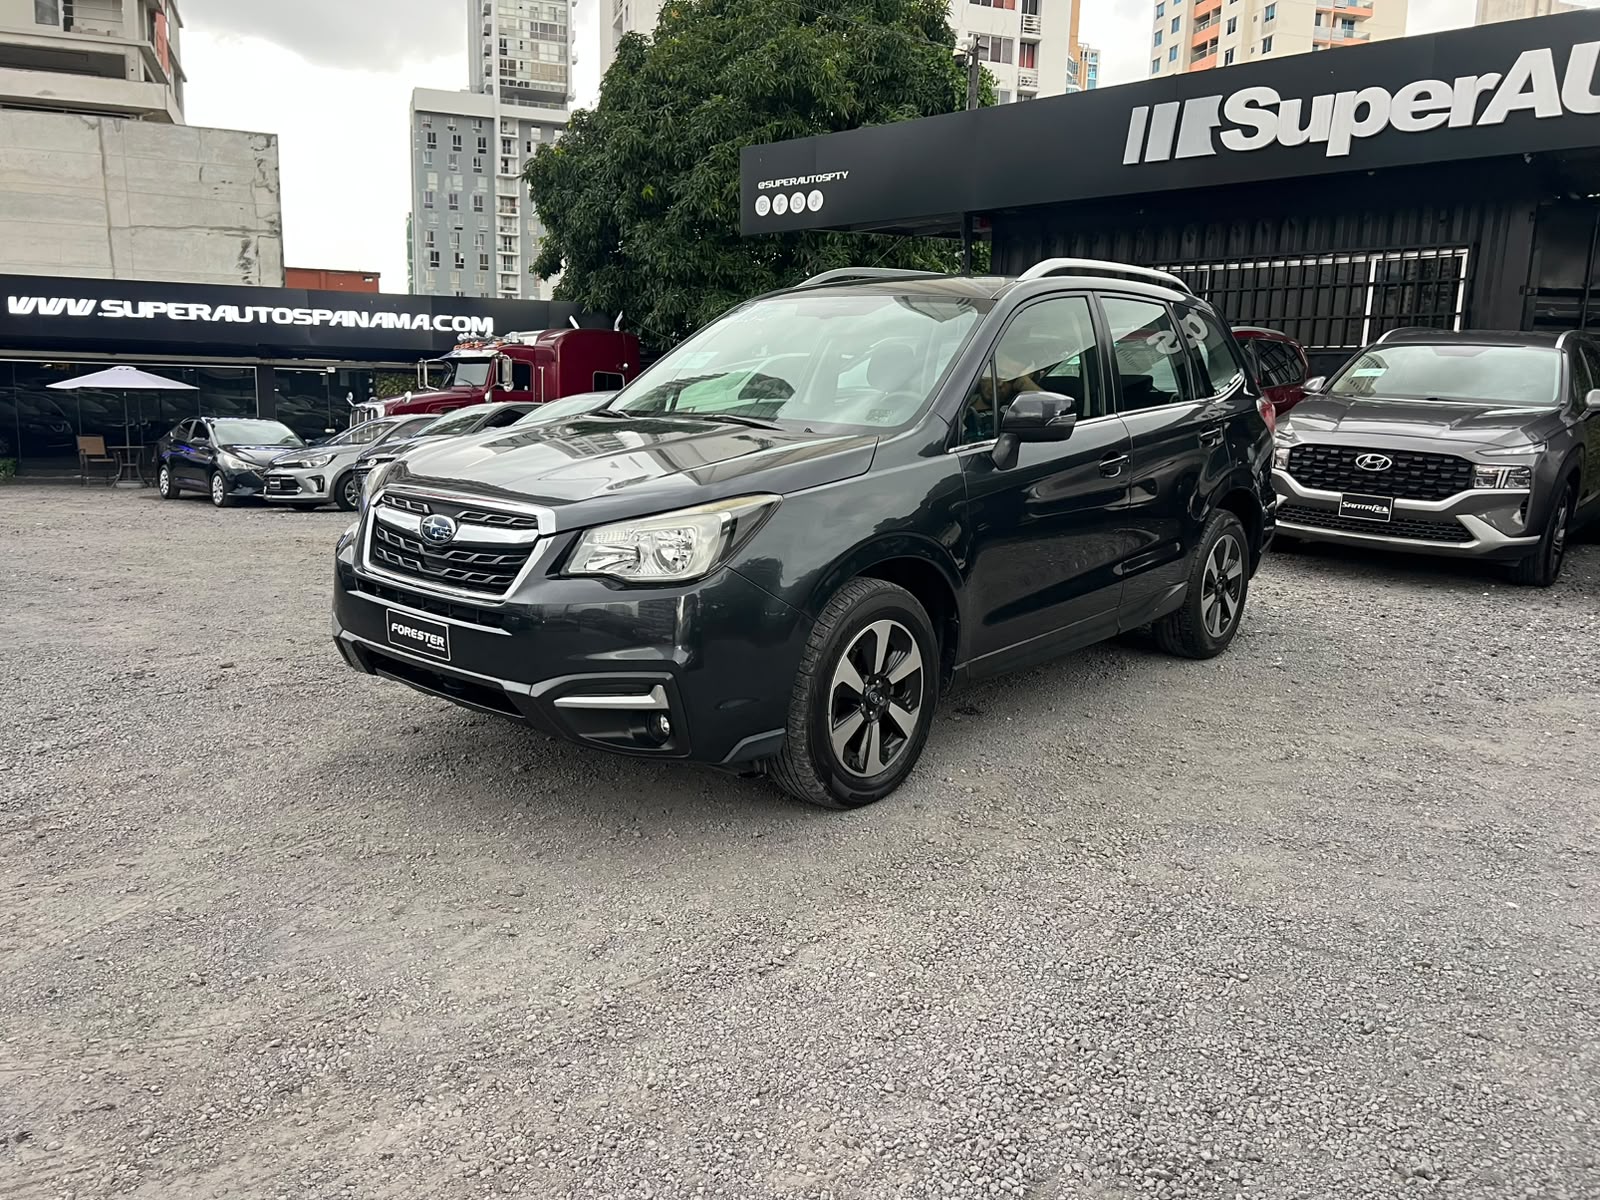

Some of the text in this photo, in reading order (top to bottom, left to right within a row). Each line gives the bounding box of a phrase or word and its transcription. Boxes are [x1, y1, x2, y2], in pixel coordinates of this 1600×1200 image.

[757, 170, 849, 190] @SUPERAUTOSPTY
[8, 295, 494, 334] WWW.SUPERAUTOSPANAMA.COM
[391, 623, 445, 647] FORESTER
